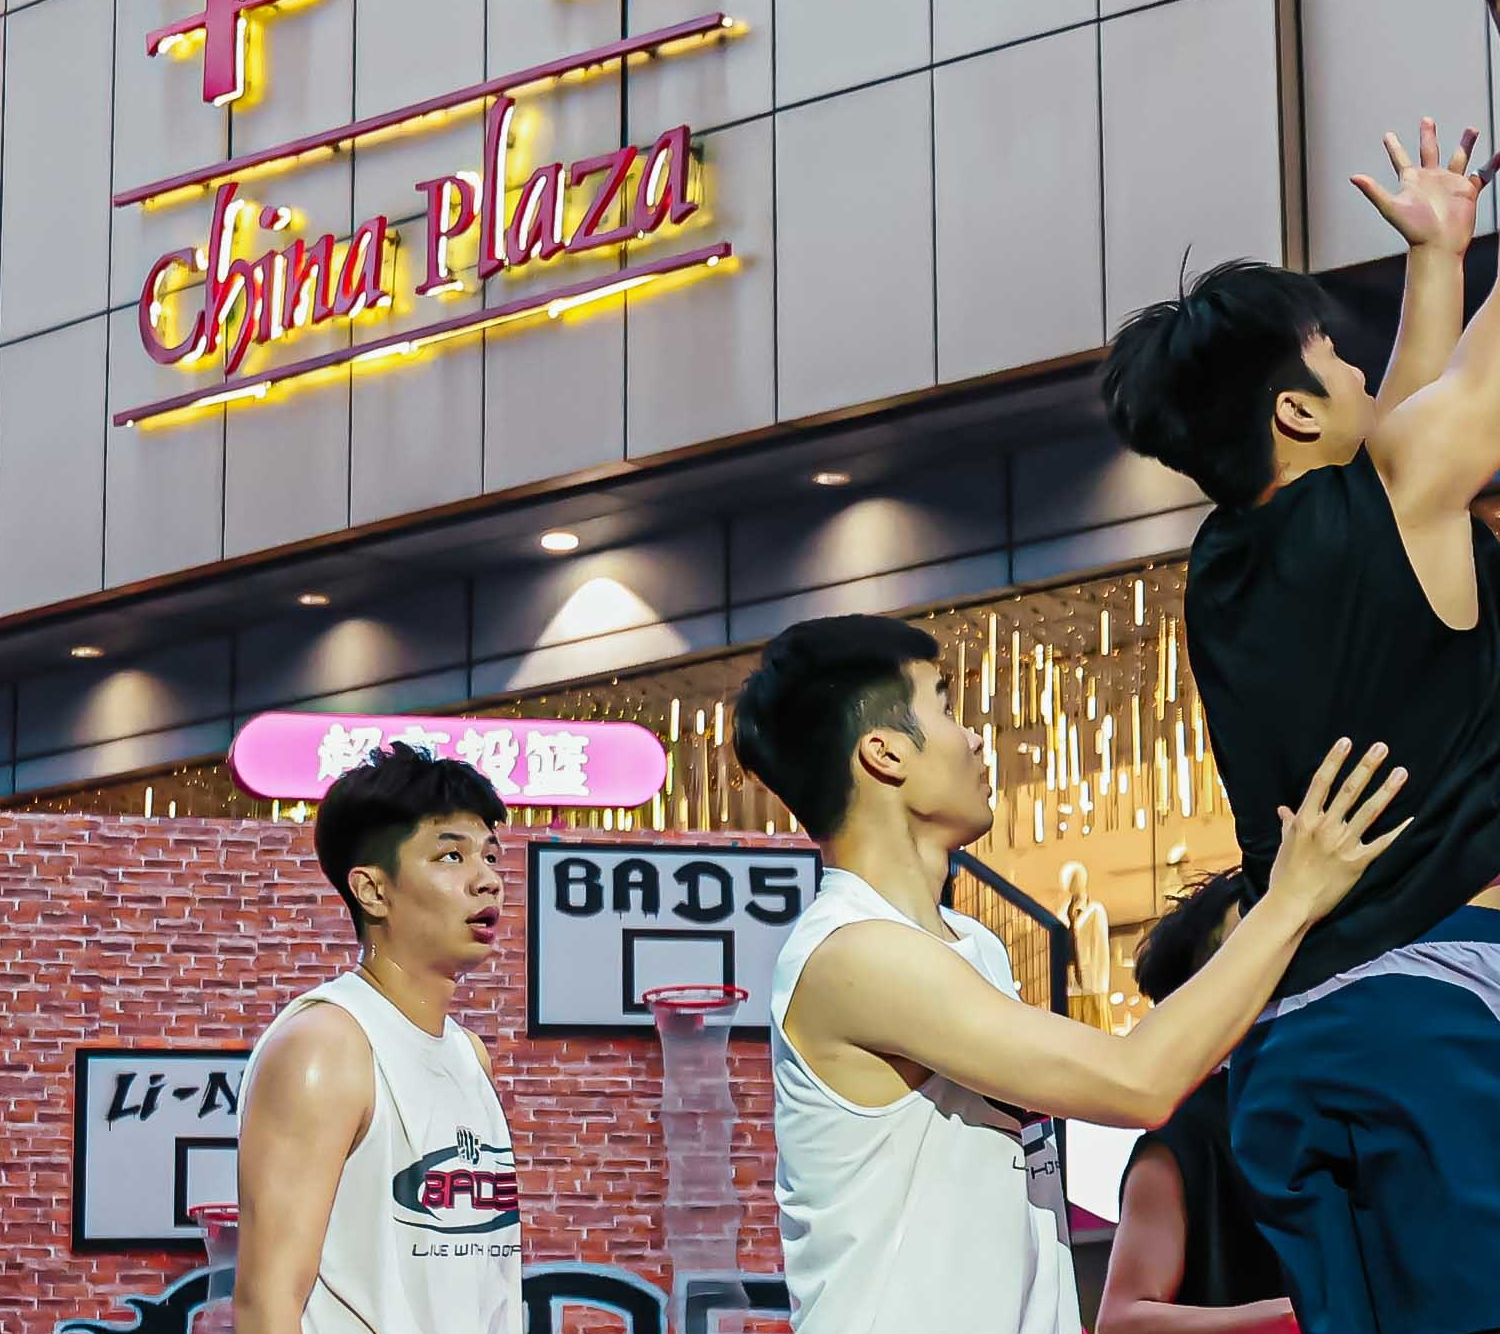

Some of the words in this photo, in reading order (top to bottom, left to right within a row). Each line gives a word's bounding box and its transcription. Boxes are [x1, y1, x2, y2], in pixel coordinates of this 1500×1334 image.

[138, 181, 388, 375] China
[415, 97, 700, 296] Plaza
[553, 857, 802, 927] BAD5
